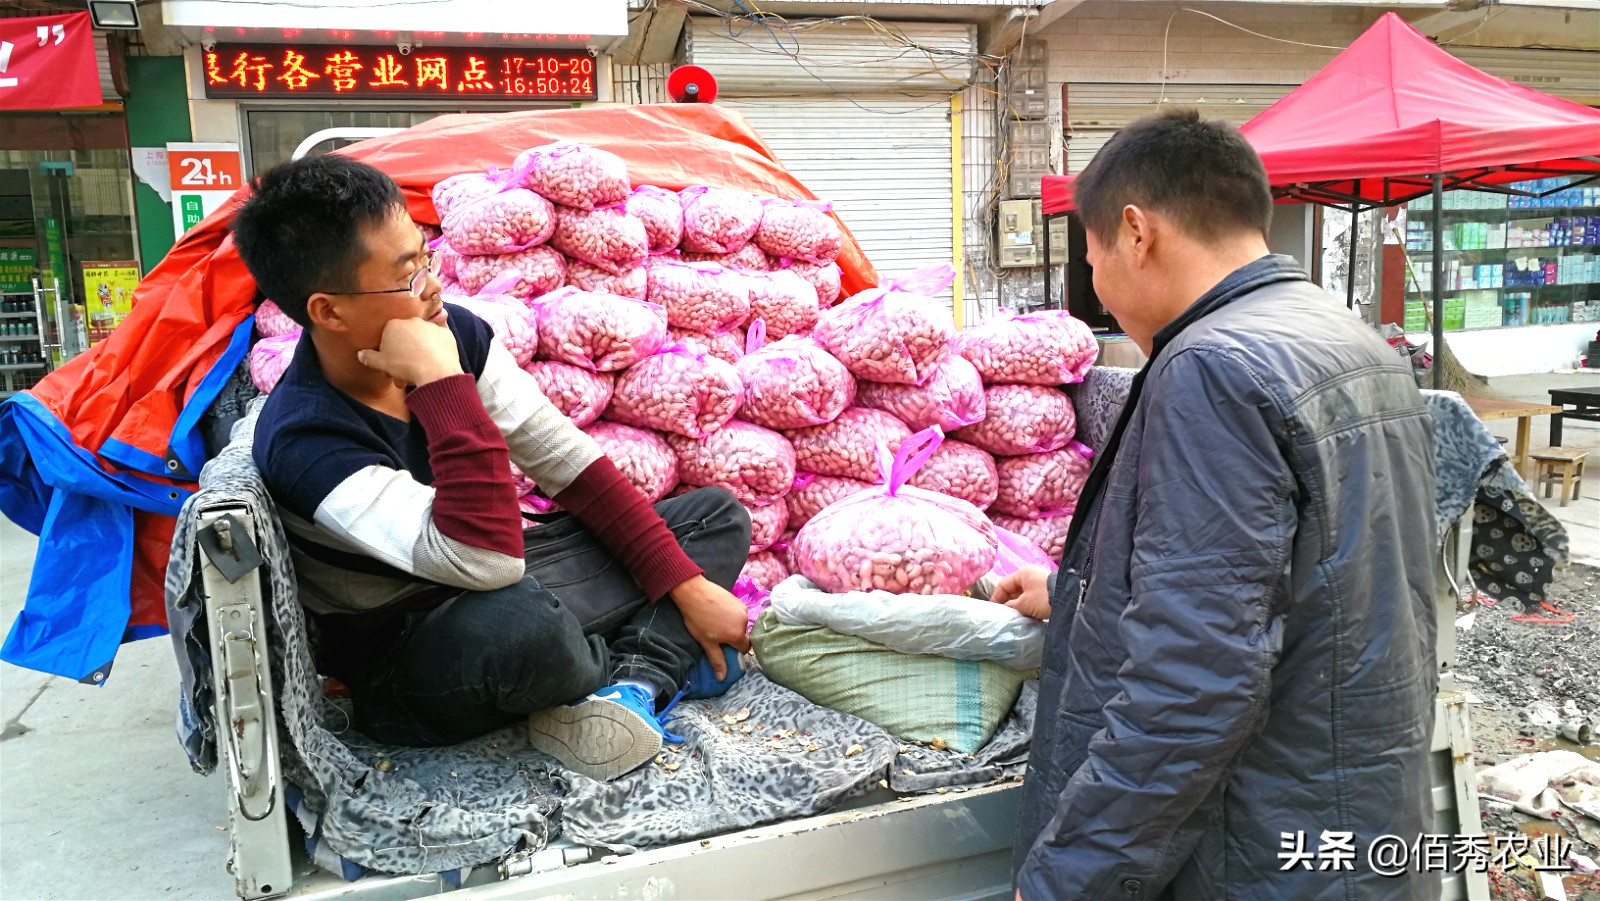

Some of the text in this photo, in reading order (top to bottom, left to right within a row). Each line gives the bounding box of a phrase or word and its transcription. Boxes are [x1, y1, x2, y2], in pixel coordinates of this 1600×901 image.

[503, 57, 592, 74] 17-10-20
[504, 77, 593, 94] 16:50:24
[186, 201, 201, 230] 自助
